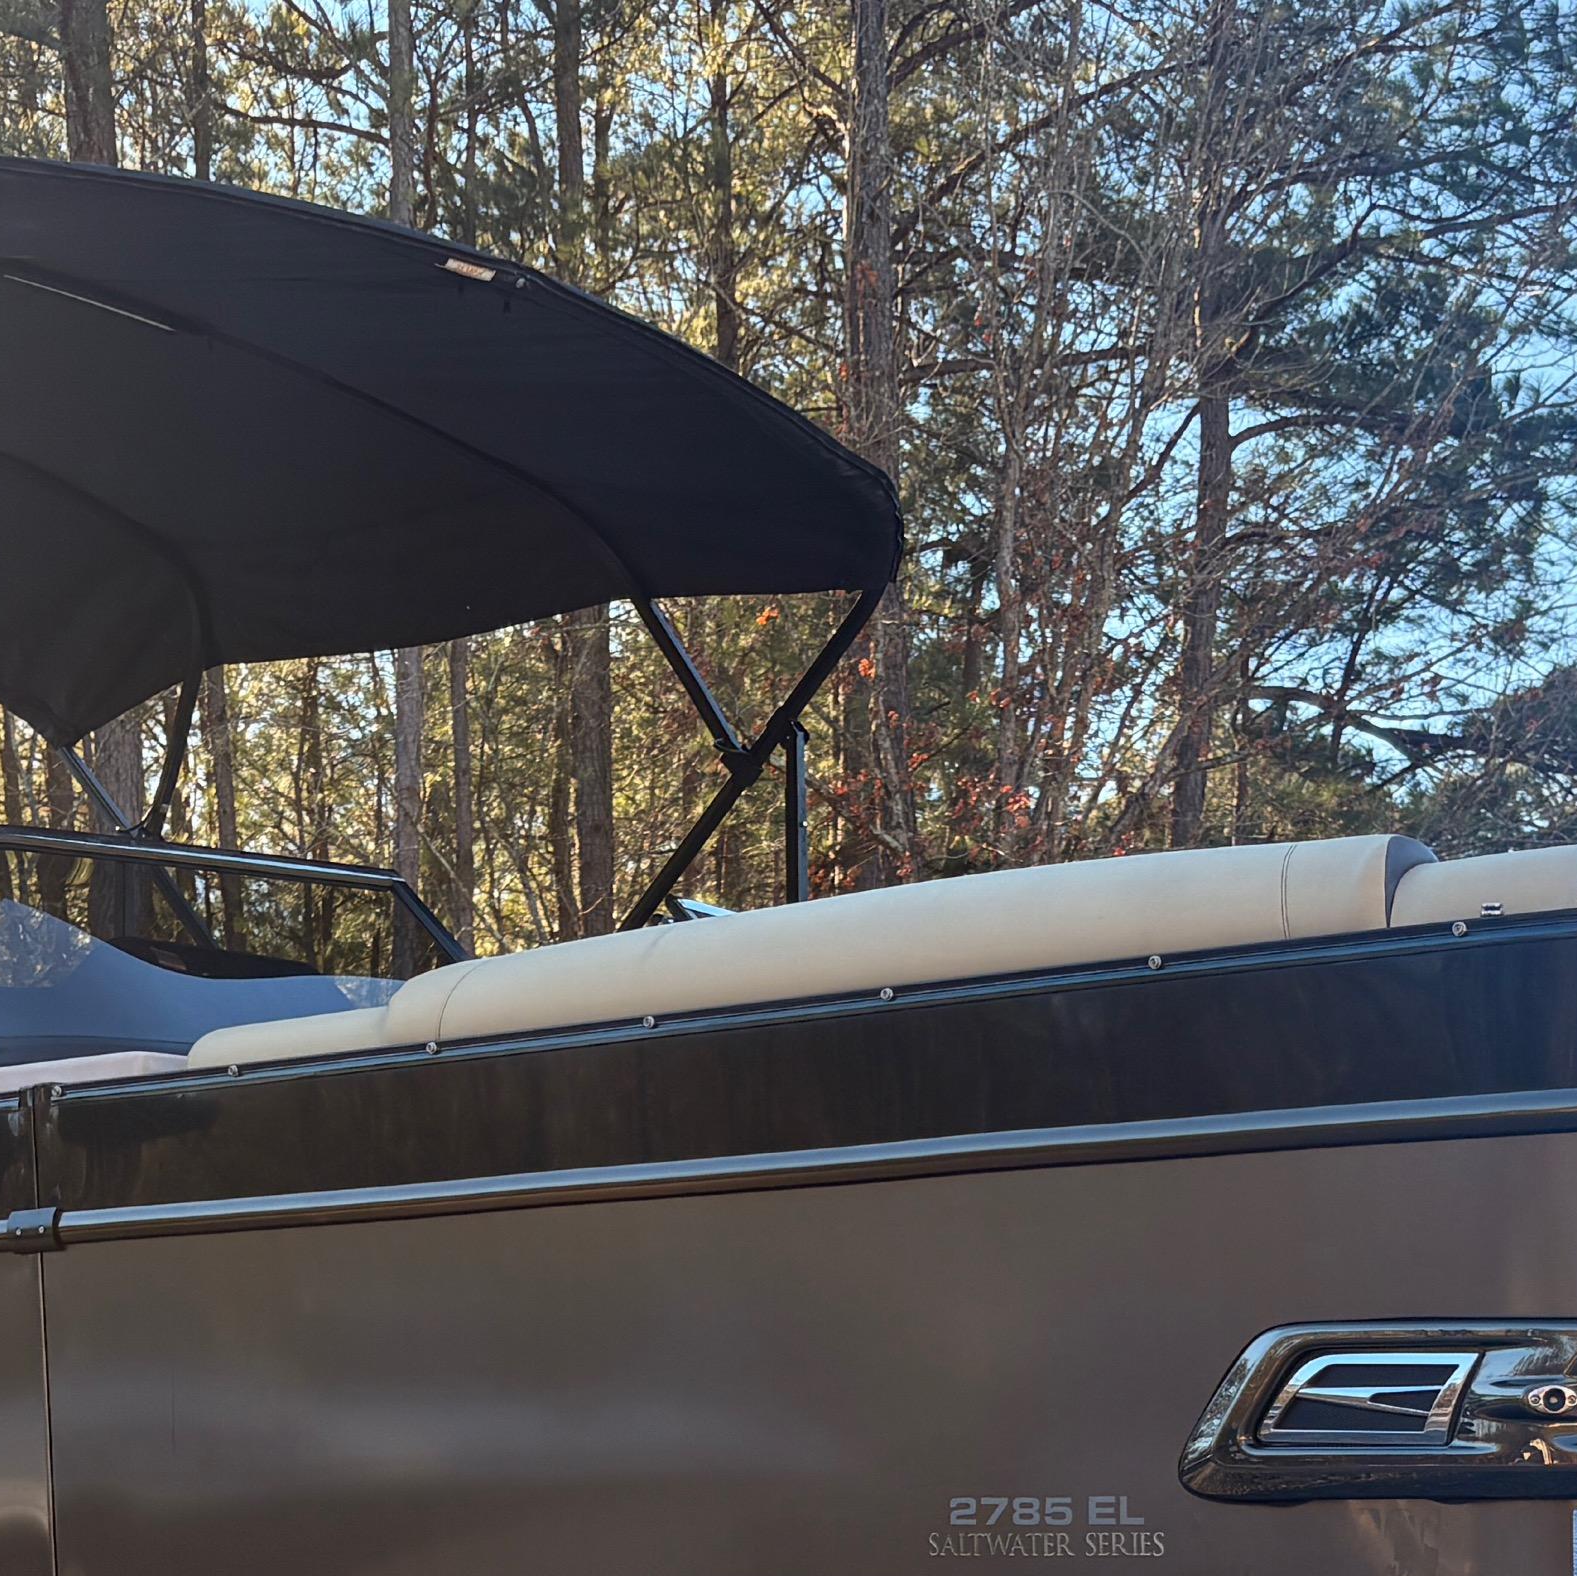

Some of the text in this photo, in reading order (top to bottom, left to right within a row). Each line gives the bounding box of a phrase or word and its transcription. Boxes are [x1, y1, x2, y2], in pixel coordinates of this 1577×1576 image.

[949, 1495, 1145, 1526] 2785 EL
[928, 1531, 1165, 1557] SALTWATER SERIES
